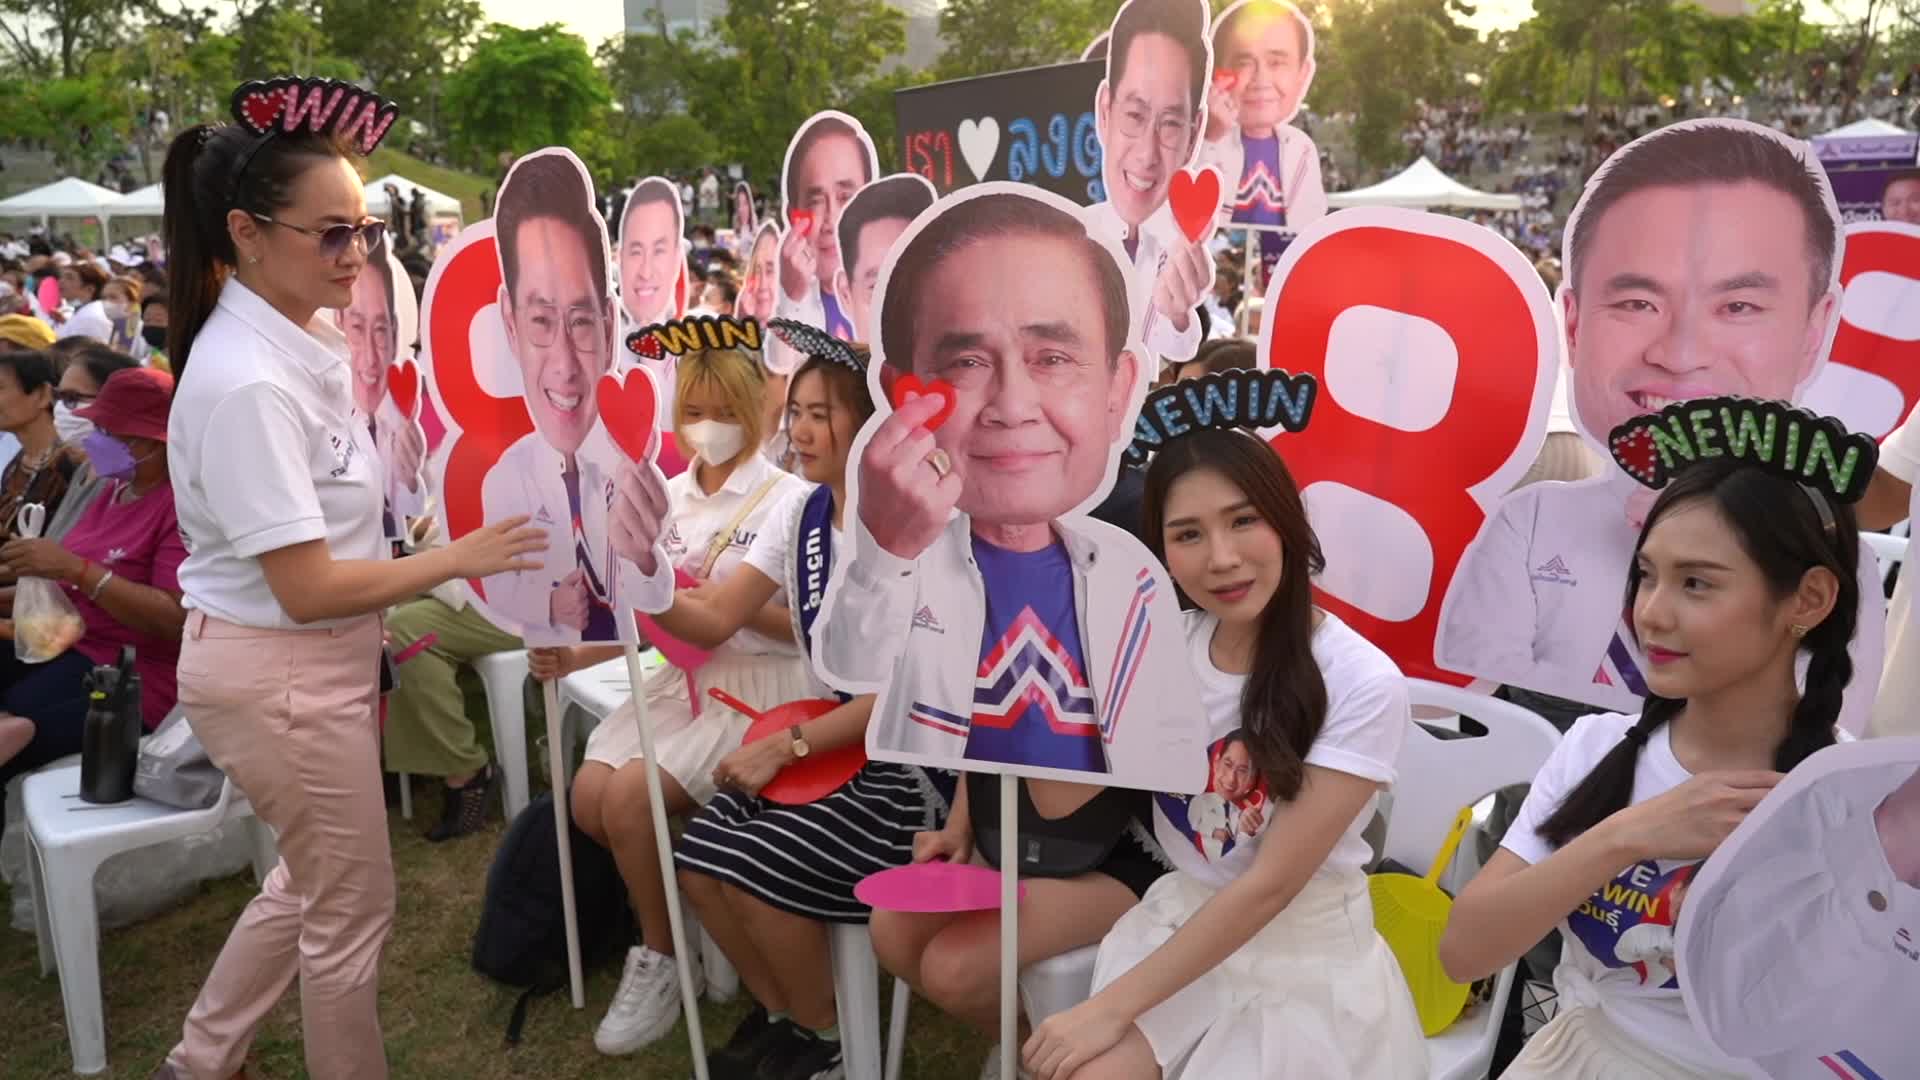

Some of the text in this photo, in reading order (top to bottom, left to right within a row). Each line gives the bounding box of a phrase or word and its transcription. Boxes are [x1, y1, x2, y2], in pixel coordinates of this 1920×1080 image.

[284, 84, 394, 151] WIN
[905, 131, 953, 185] เรา
[654, 318, 759, 354] WIN
[1127, 379, 1309, 459] NEWIN
[1648, 407, 1859, 494] NEWIN
[1594, 880, 1660, 918] WIN
